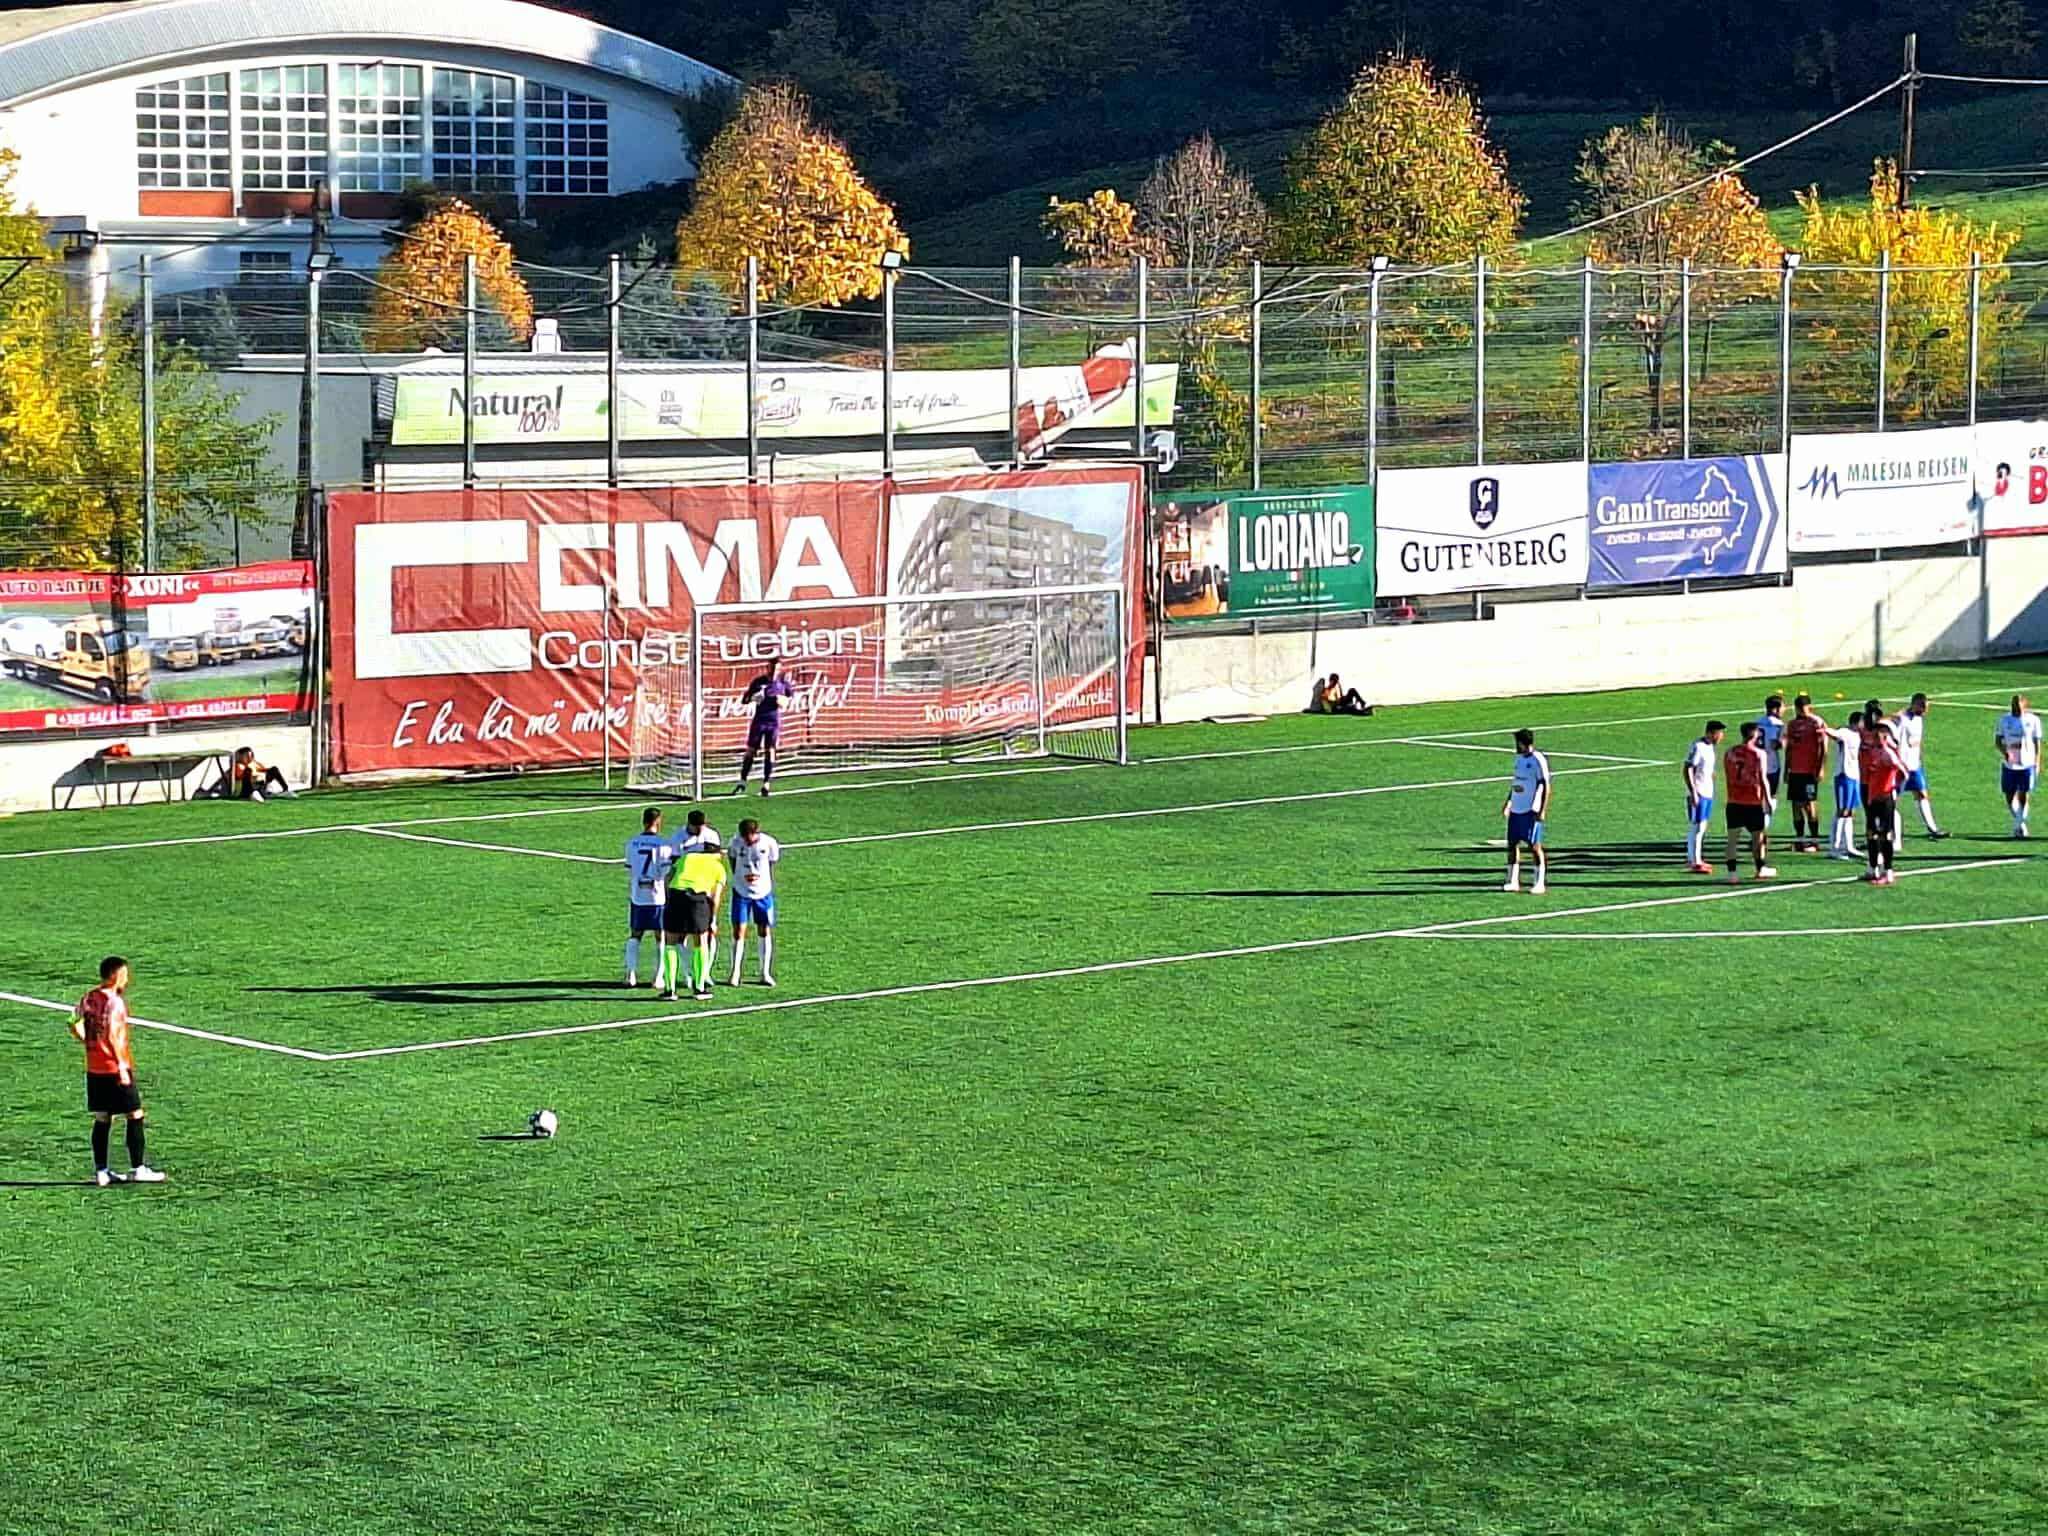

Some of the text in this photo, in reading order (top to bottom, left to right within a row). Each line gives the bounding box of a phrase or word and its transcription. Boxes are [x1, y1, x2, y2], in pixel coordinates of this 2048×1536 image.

[448, 384, 563, 417] Natural
[1846, 456, 1967, 483] MALESIA REISEN
[1596, 493, 1732, 526] Gani Transport
[1400, 533, 1567, 573] GUTENBERG
[391, 700, 427, 748] E
[427, 697, 463, 744] ku
[477, 696, 513, 741] ka
[636, 847, 653, 877] 7
